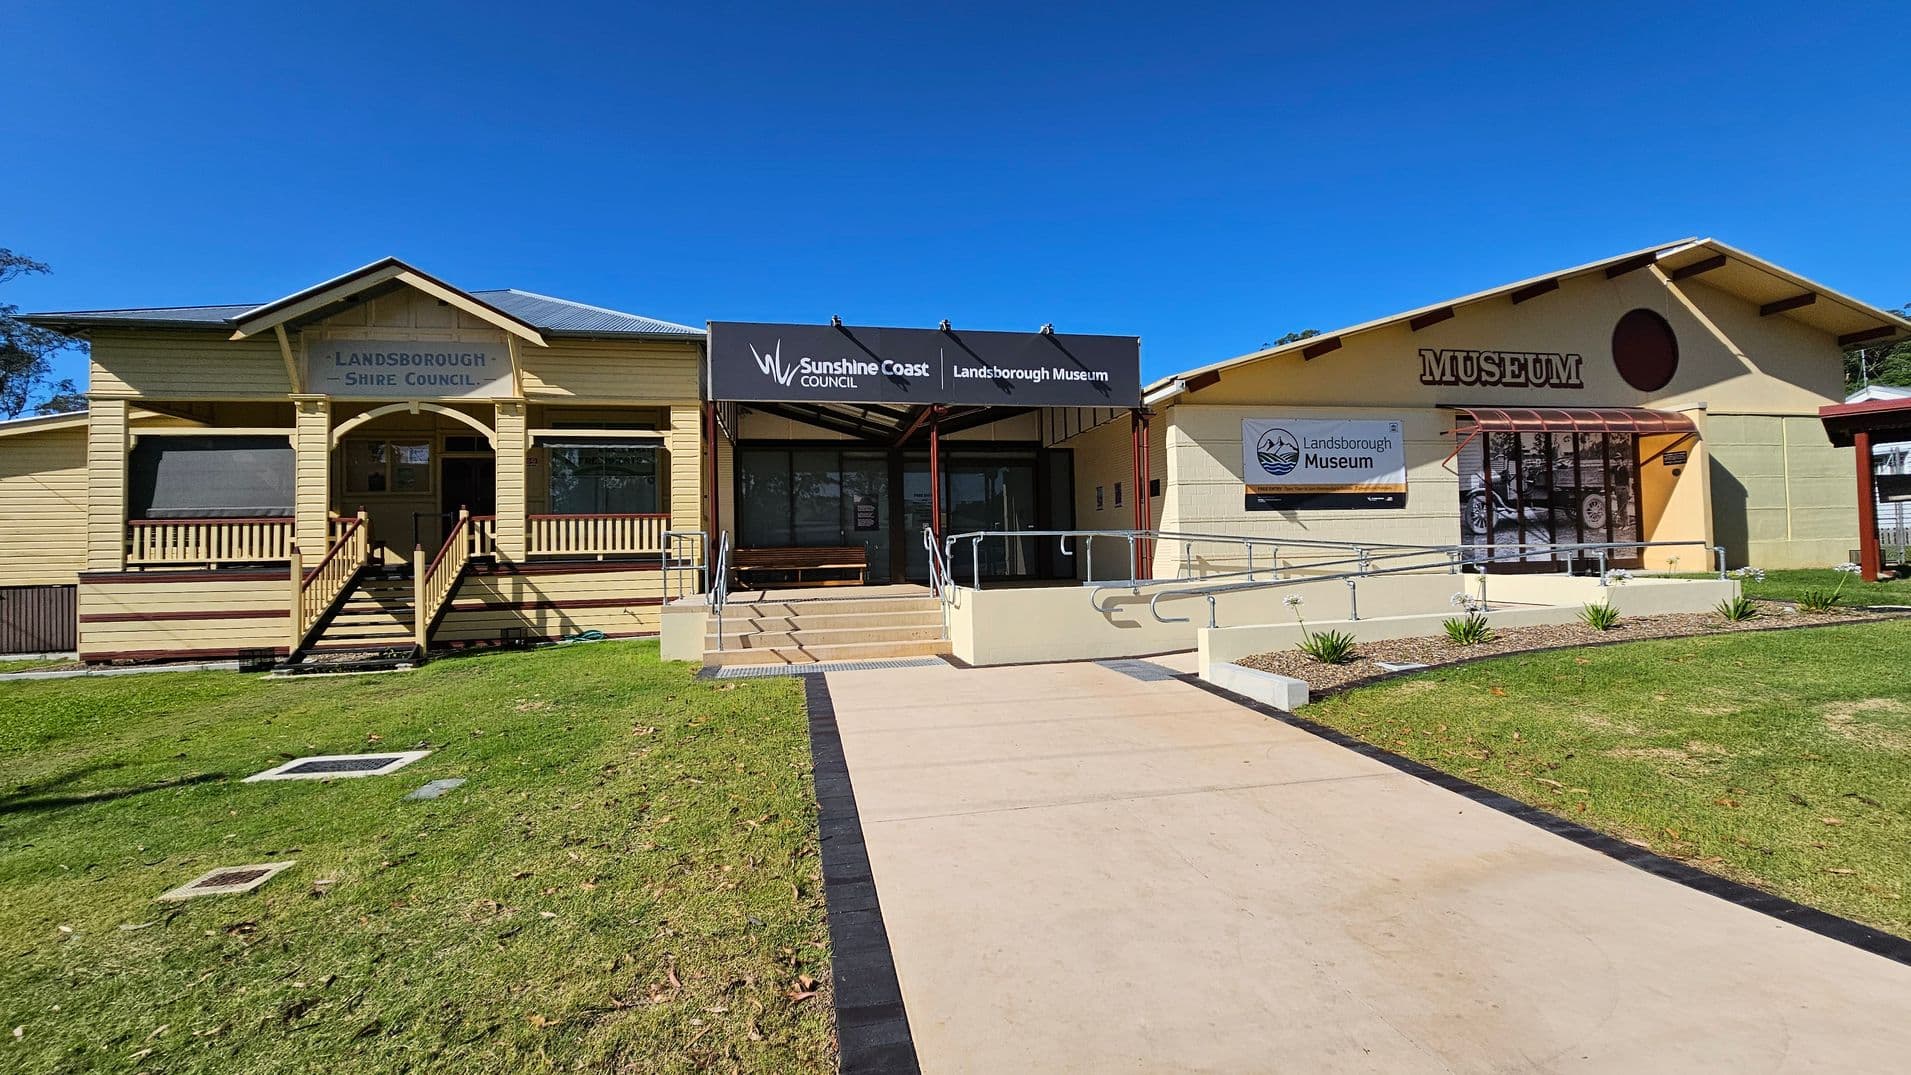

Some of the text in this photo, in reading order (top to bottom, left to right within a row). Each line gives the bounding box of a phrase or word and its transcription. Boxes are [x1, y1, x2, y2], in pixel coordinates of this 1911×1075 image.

[335, 351, 486, 367] LANDSBOROUGH
[800, 357, 930, 377] Sunshine Coast
[953, 365, 1109, 383] Landsborough Museum
[1418, 348, 1584, 389] MUSEUM
[345, 371, 397, 386] SHIRE
[800, 375, 858, 388] COUNCIL
[1303, 436, 1392, 453] Landsborough
[1304, 453, 1374, 469] Museum
